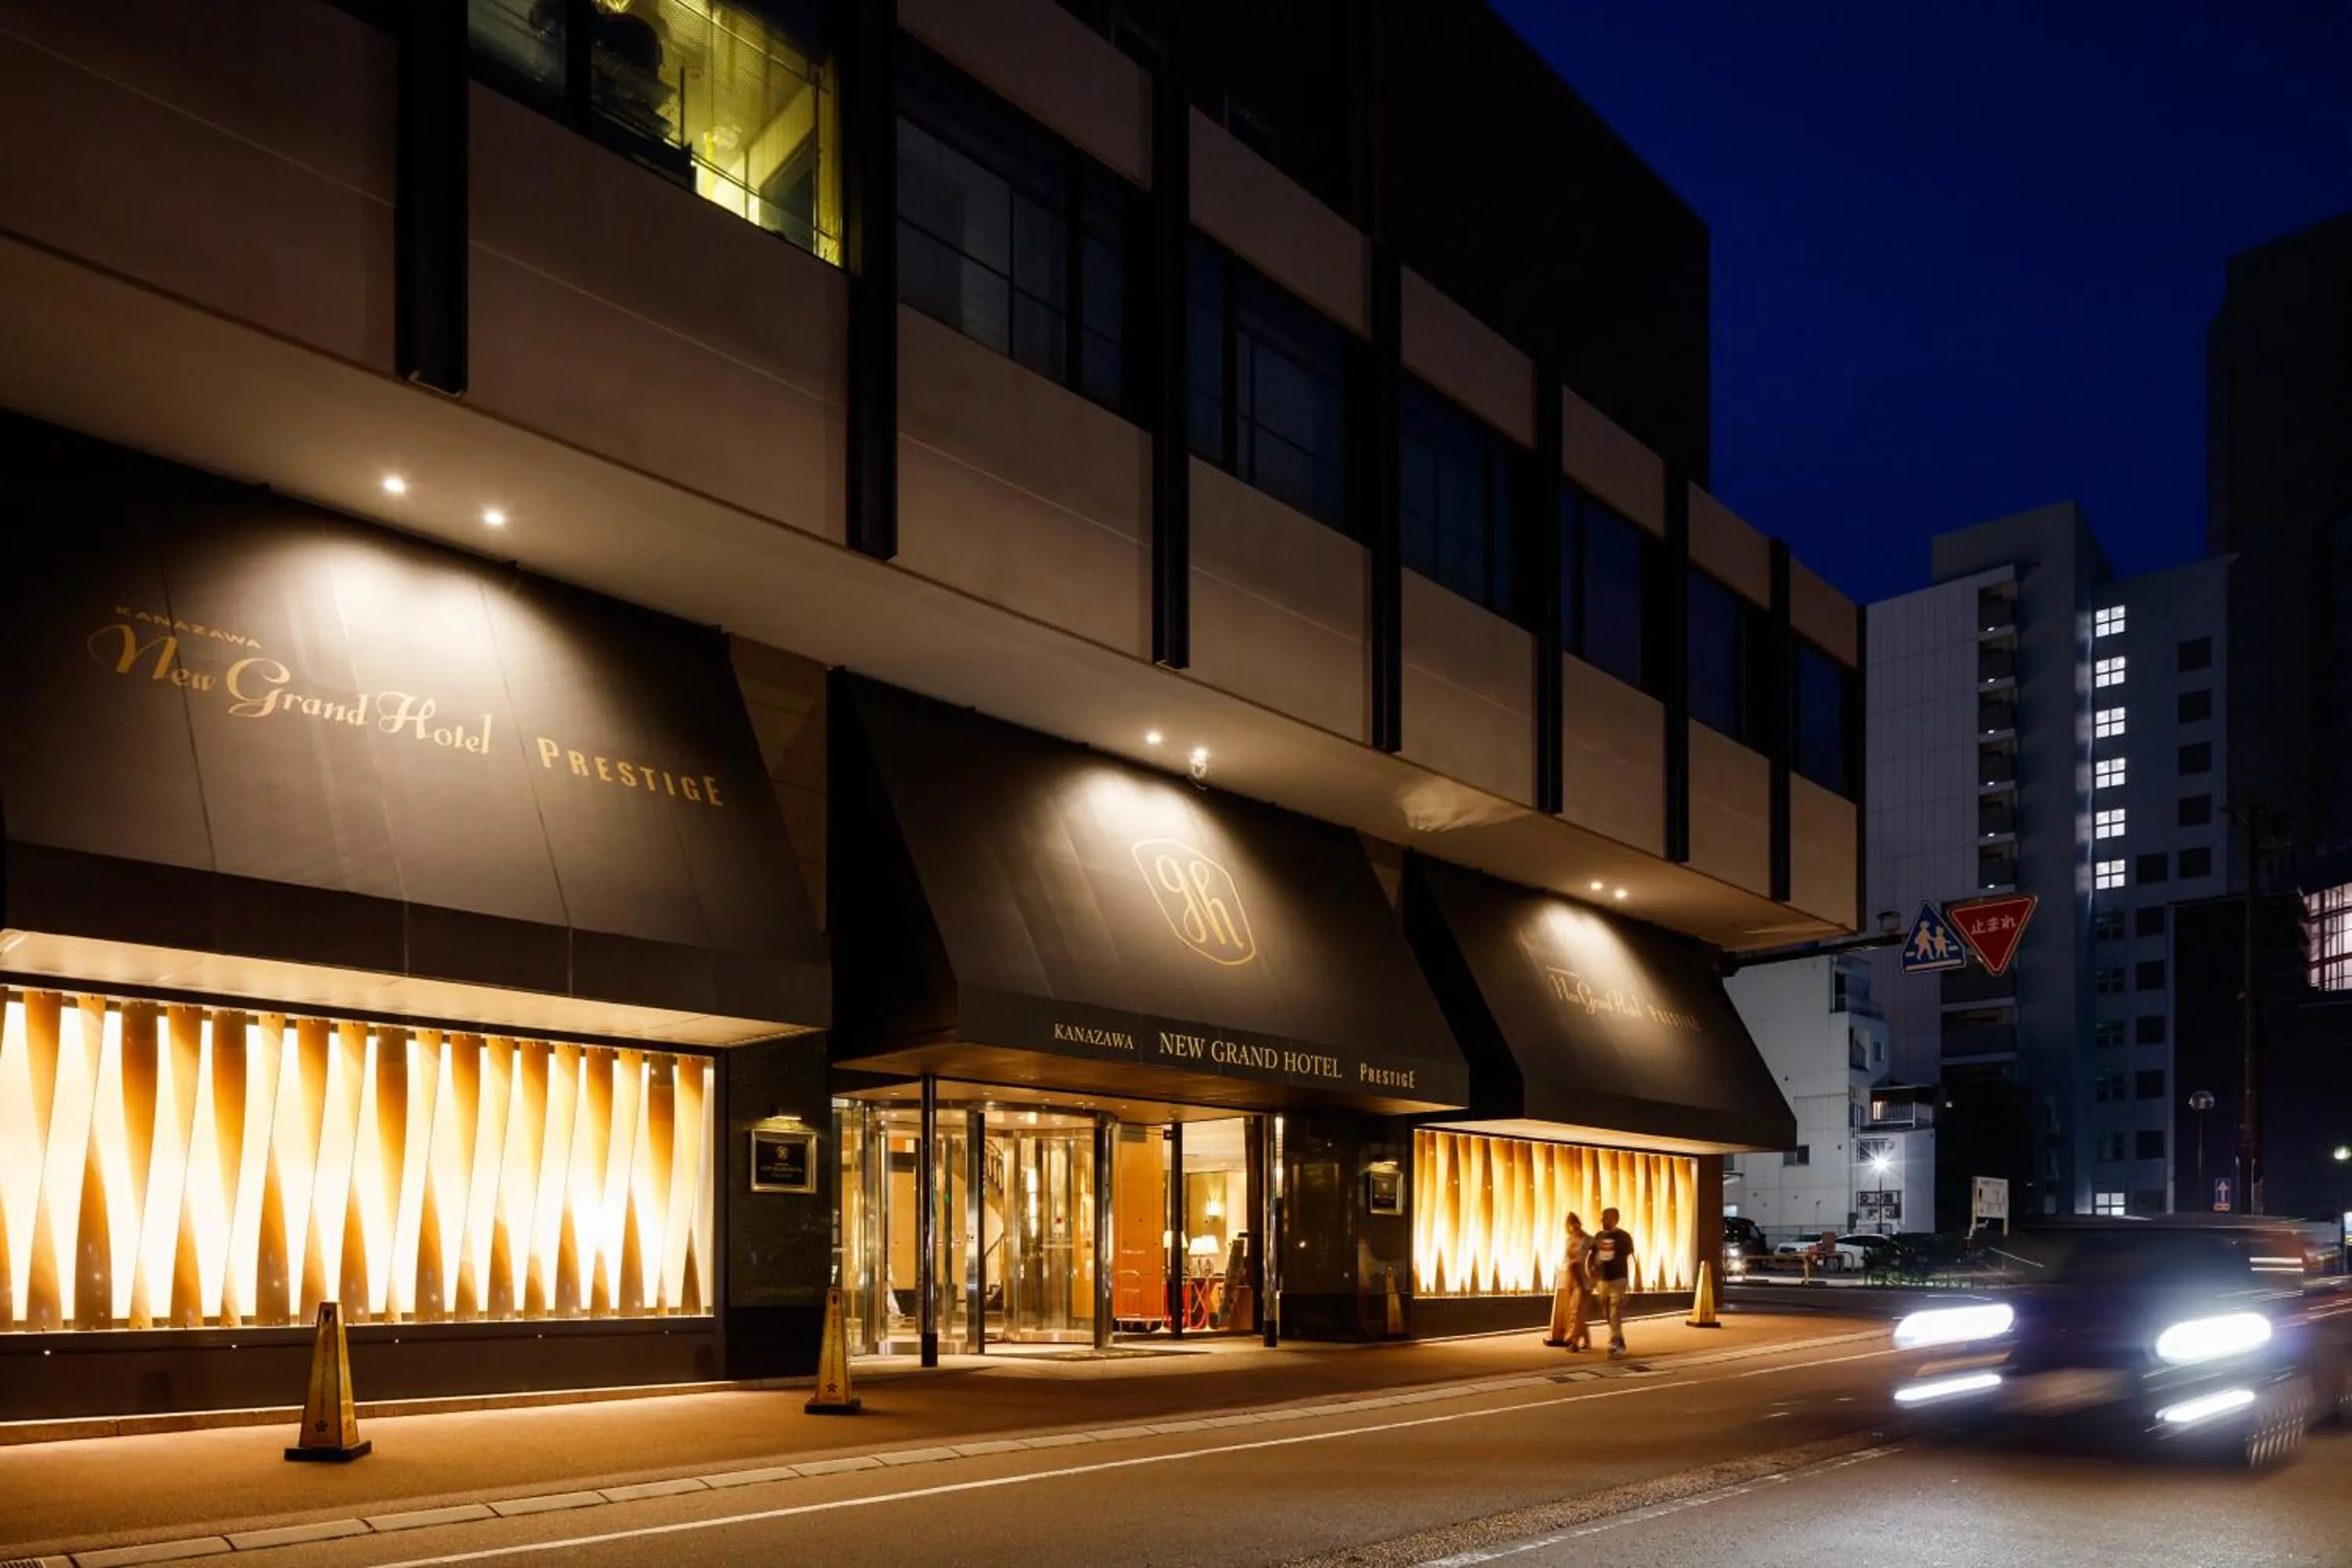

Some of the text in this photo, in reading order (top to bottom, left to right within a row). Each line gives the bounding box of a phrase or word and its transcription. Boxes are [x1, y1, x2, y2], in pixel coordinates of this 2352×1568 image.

[116, 605, 262, 650] KANAZAWA
[87, 624, 724, 805] New Grand Hotel PRESTIGE
[1970, 914, 2016, 935] 止まれ
[1054, 1022, 1134, 1051] KANAZAWA
[1159, 1032, 1206, 1059] NEW
[1211, 1040, 1278, 1070] GRAND
[1283, 1051, 1343, 1079] HOTEL
